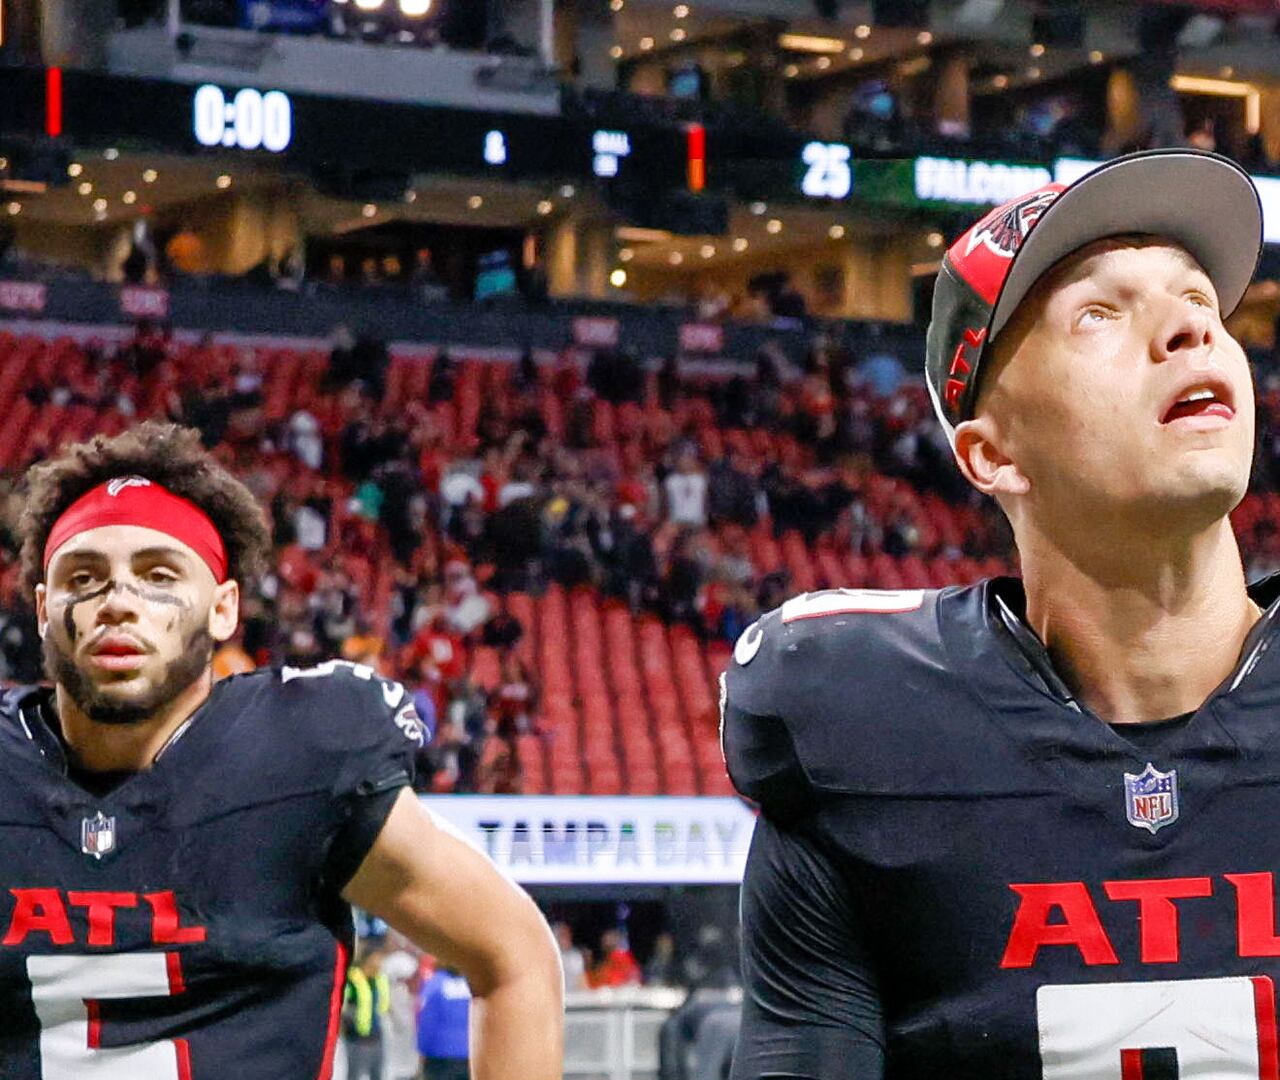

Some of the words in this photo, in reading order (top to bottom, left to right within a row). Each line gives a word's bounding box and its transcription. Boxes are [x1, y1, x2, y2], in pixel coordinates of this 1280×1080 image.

[194, 84, 291, 152] 0:00
[803, 142, 852, 199] 25
[1134, 795, 1171, 820] NFL
[477, 821, 639, 866] TAMPA
[653, 821, 739, 867] BAY
[1, 887, 207, 945] ATL
